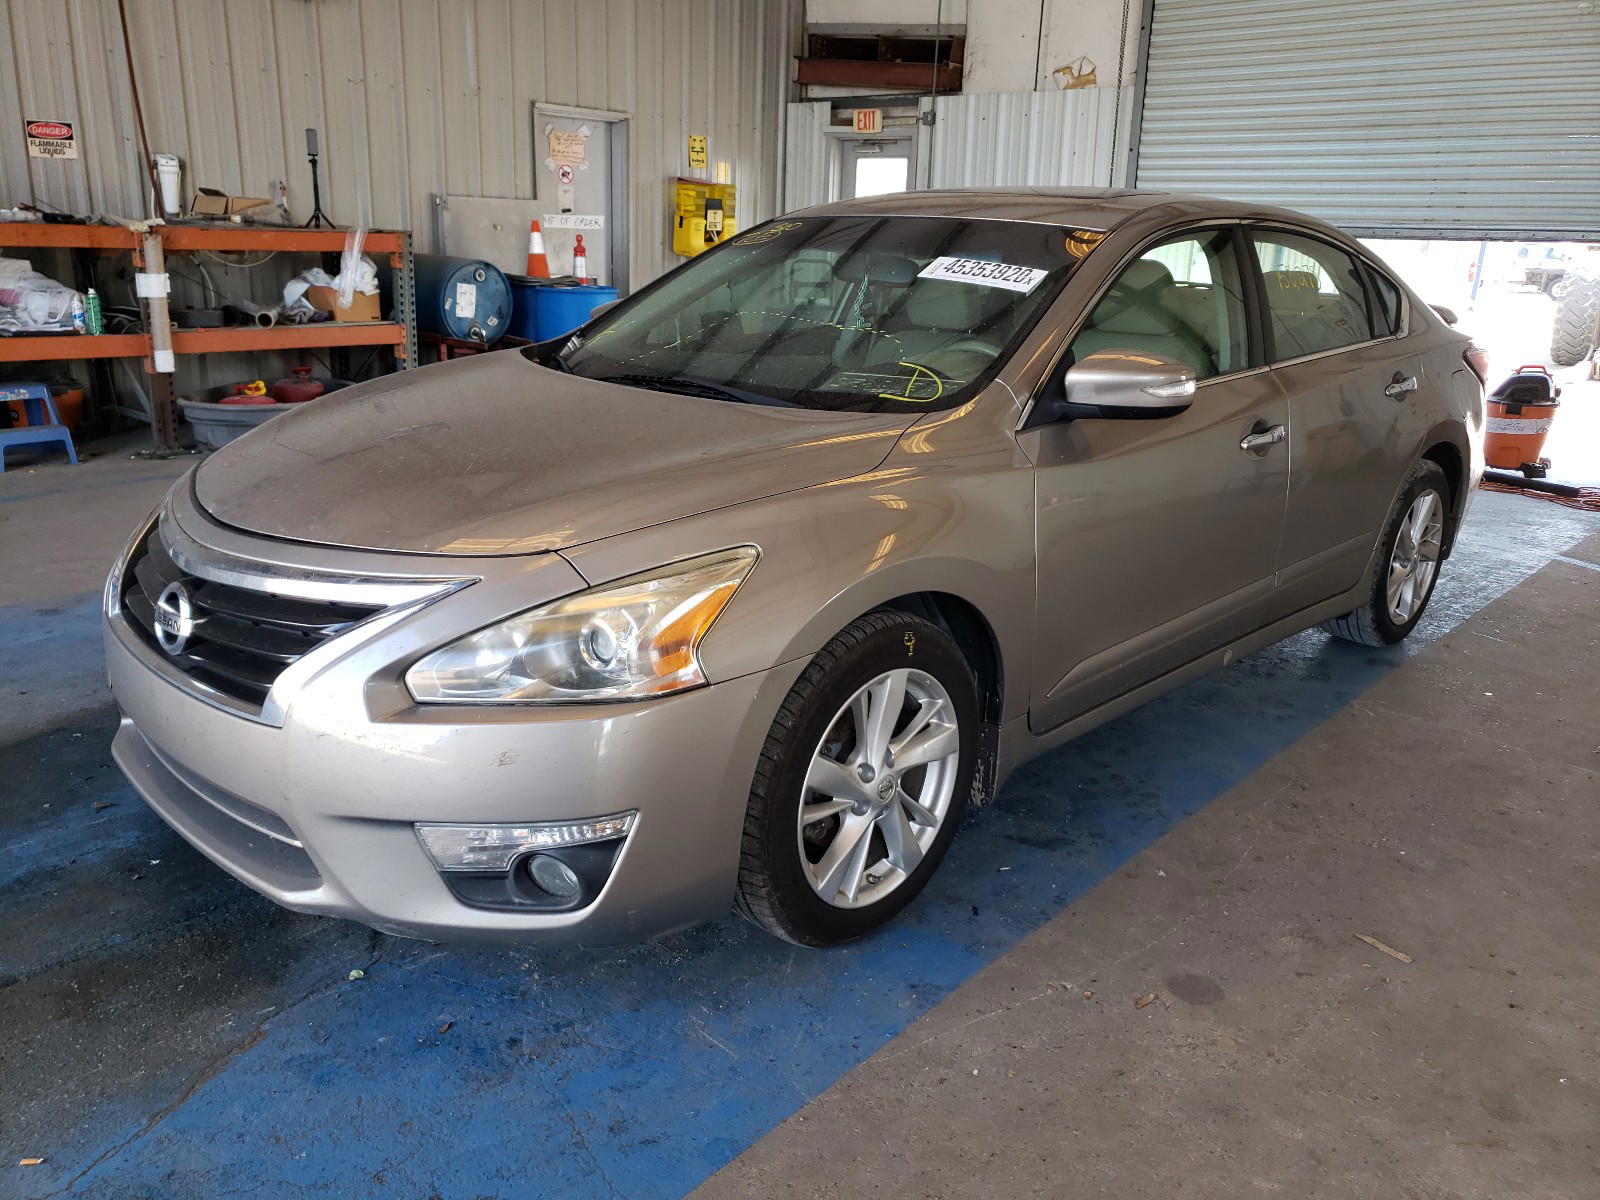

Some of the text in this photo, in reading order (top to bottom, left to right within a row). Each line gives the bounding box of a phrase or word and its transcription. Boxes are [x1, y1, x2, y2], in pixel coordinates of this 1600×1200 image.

[857, 110, 876, 130] EXIT
[32, 125, 68, 135] DANGER
[30, 140, 73, 148] FLAMMABLE
[39, 148, 66, 157] LIQUIDS
[561, 215, 572, 225] OF
